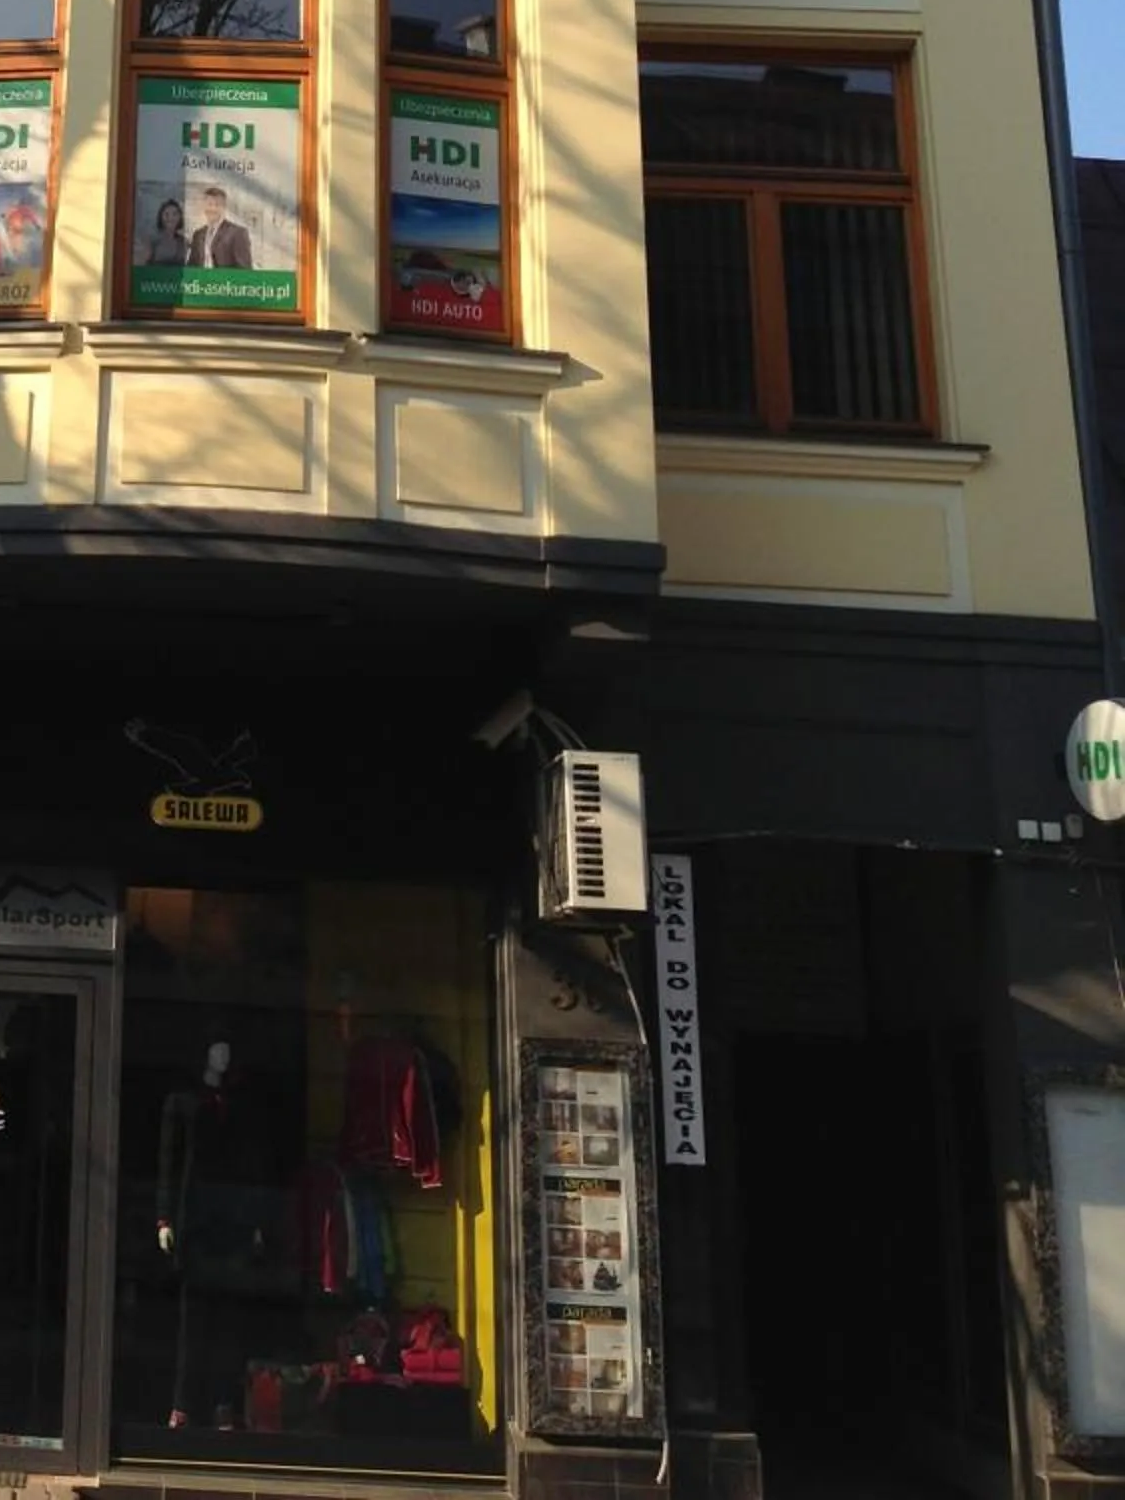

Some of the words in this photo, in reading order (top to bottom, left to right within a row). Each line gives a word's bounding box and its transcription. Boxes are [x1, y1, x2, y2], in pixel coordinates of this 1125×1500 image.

[171, 85, 268, 104] Ubezpieczenia
[182, 121, 255, 150] HDI
[181, 154, 256, 174] Asekuracja
[410, 135, 480, 169] HDI
[410, 169, 481, 192] Asekuracja
[412, 299, 438, 315] HDI
[442, 302, 482, 321] AUTO
[1077, 739, 1122, 781] HDI
[165, 799, 249, 824] SALEWA
[663, 865, 686, 942] LOKAL
[666, 960, 690, 990] DO
